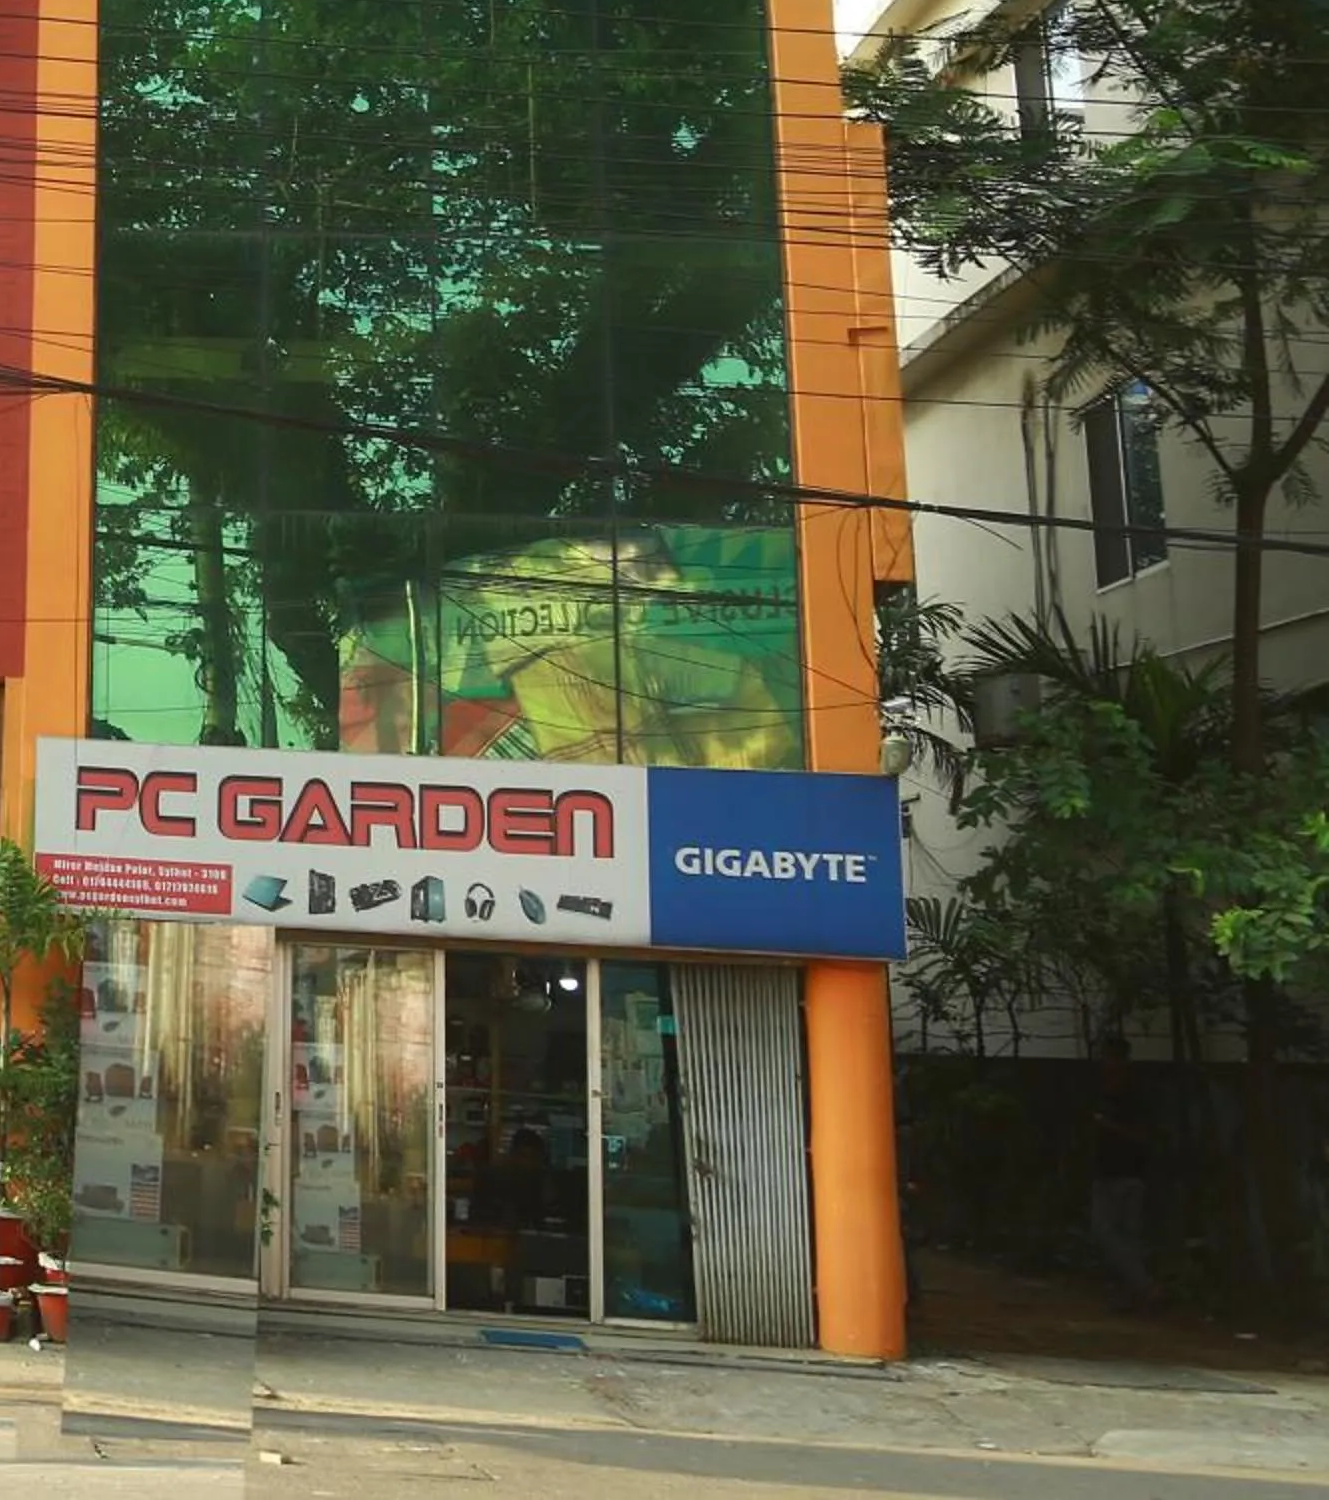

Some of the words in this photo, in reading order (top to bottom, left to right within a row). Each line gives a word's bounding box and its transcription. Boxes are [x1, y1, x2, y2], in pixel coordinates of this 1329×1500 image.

[75, 766, 198, 837] PC
[217, 776, 614, 858] GARDEN
[674, 846, 868, 883] GIGABYTE
